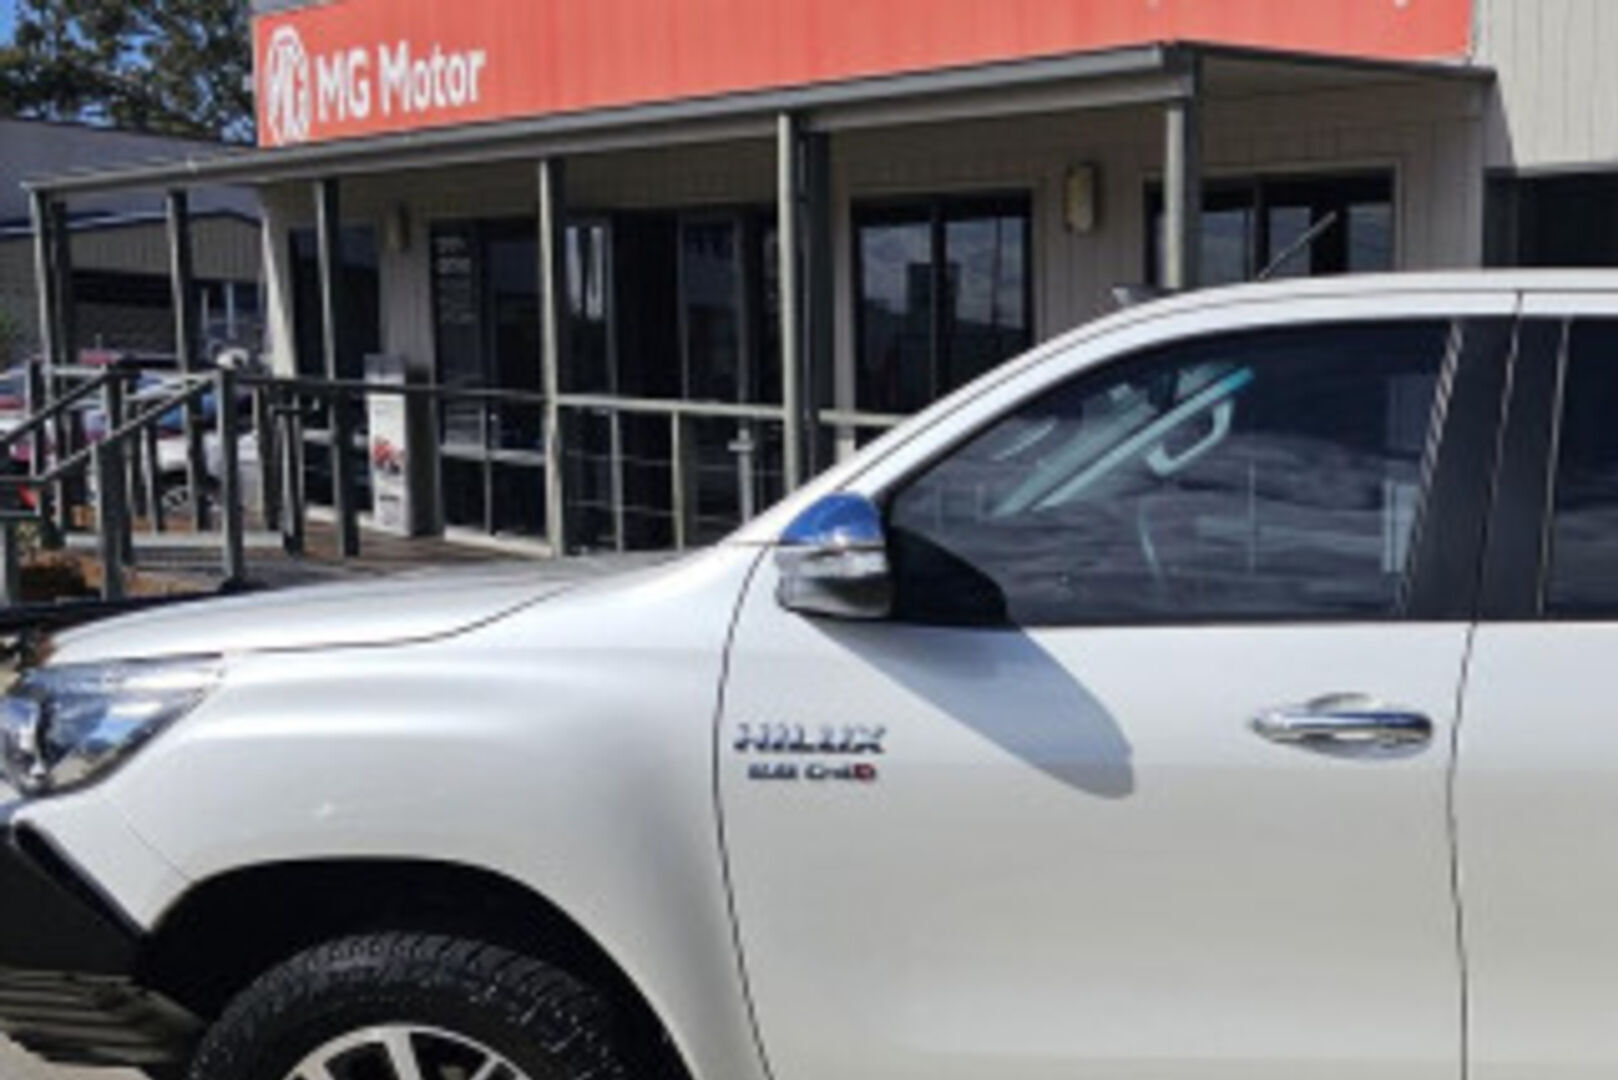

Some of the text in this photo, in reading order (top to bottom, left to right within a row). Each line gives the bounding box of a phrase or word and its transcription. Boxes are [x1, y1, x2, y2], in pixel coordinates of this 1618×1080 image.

[316, 40, 486, 122] MG Motor
[734, 723, 886, 753] HILUX
